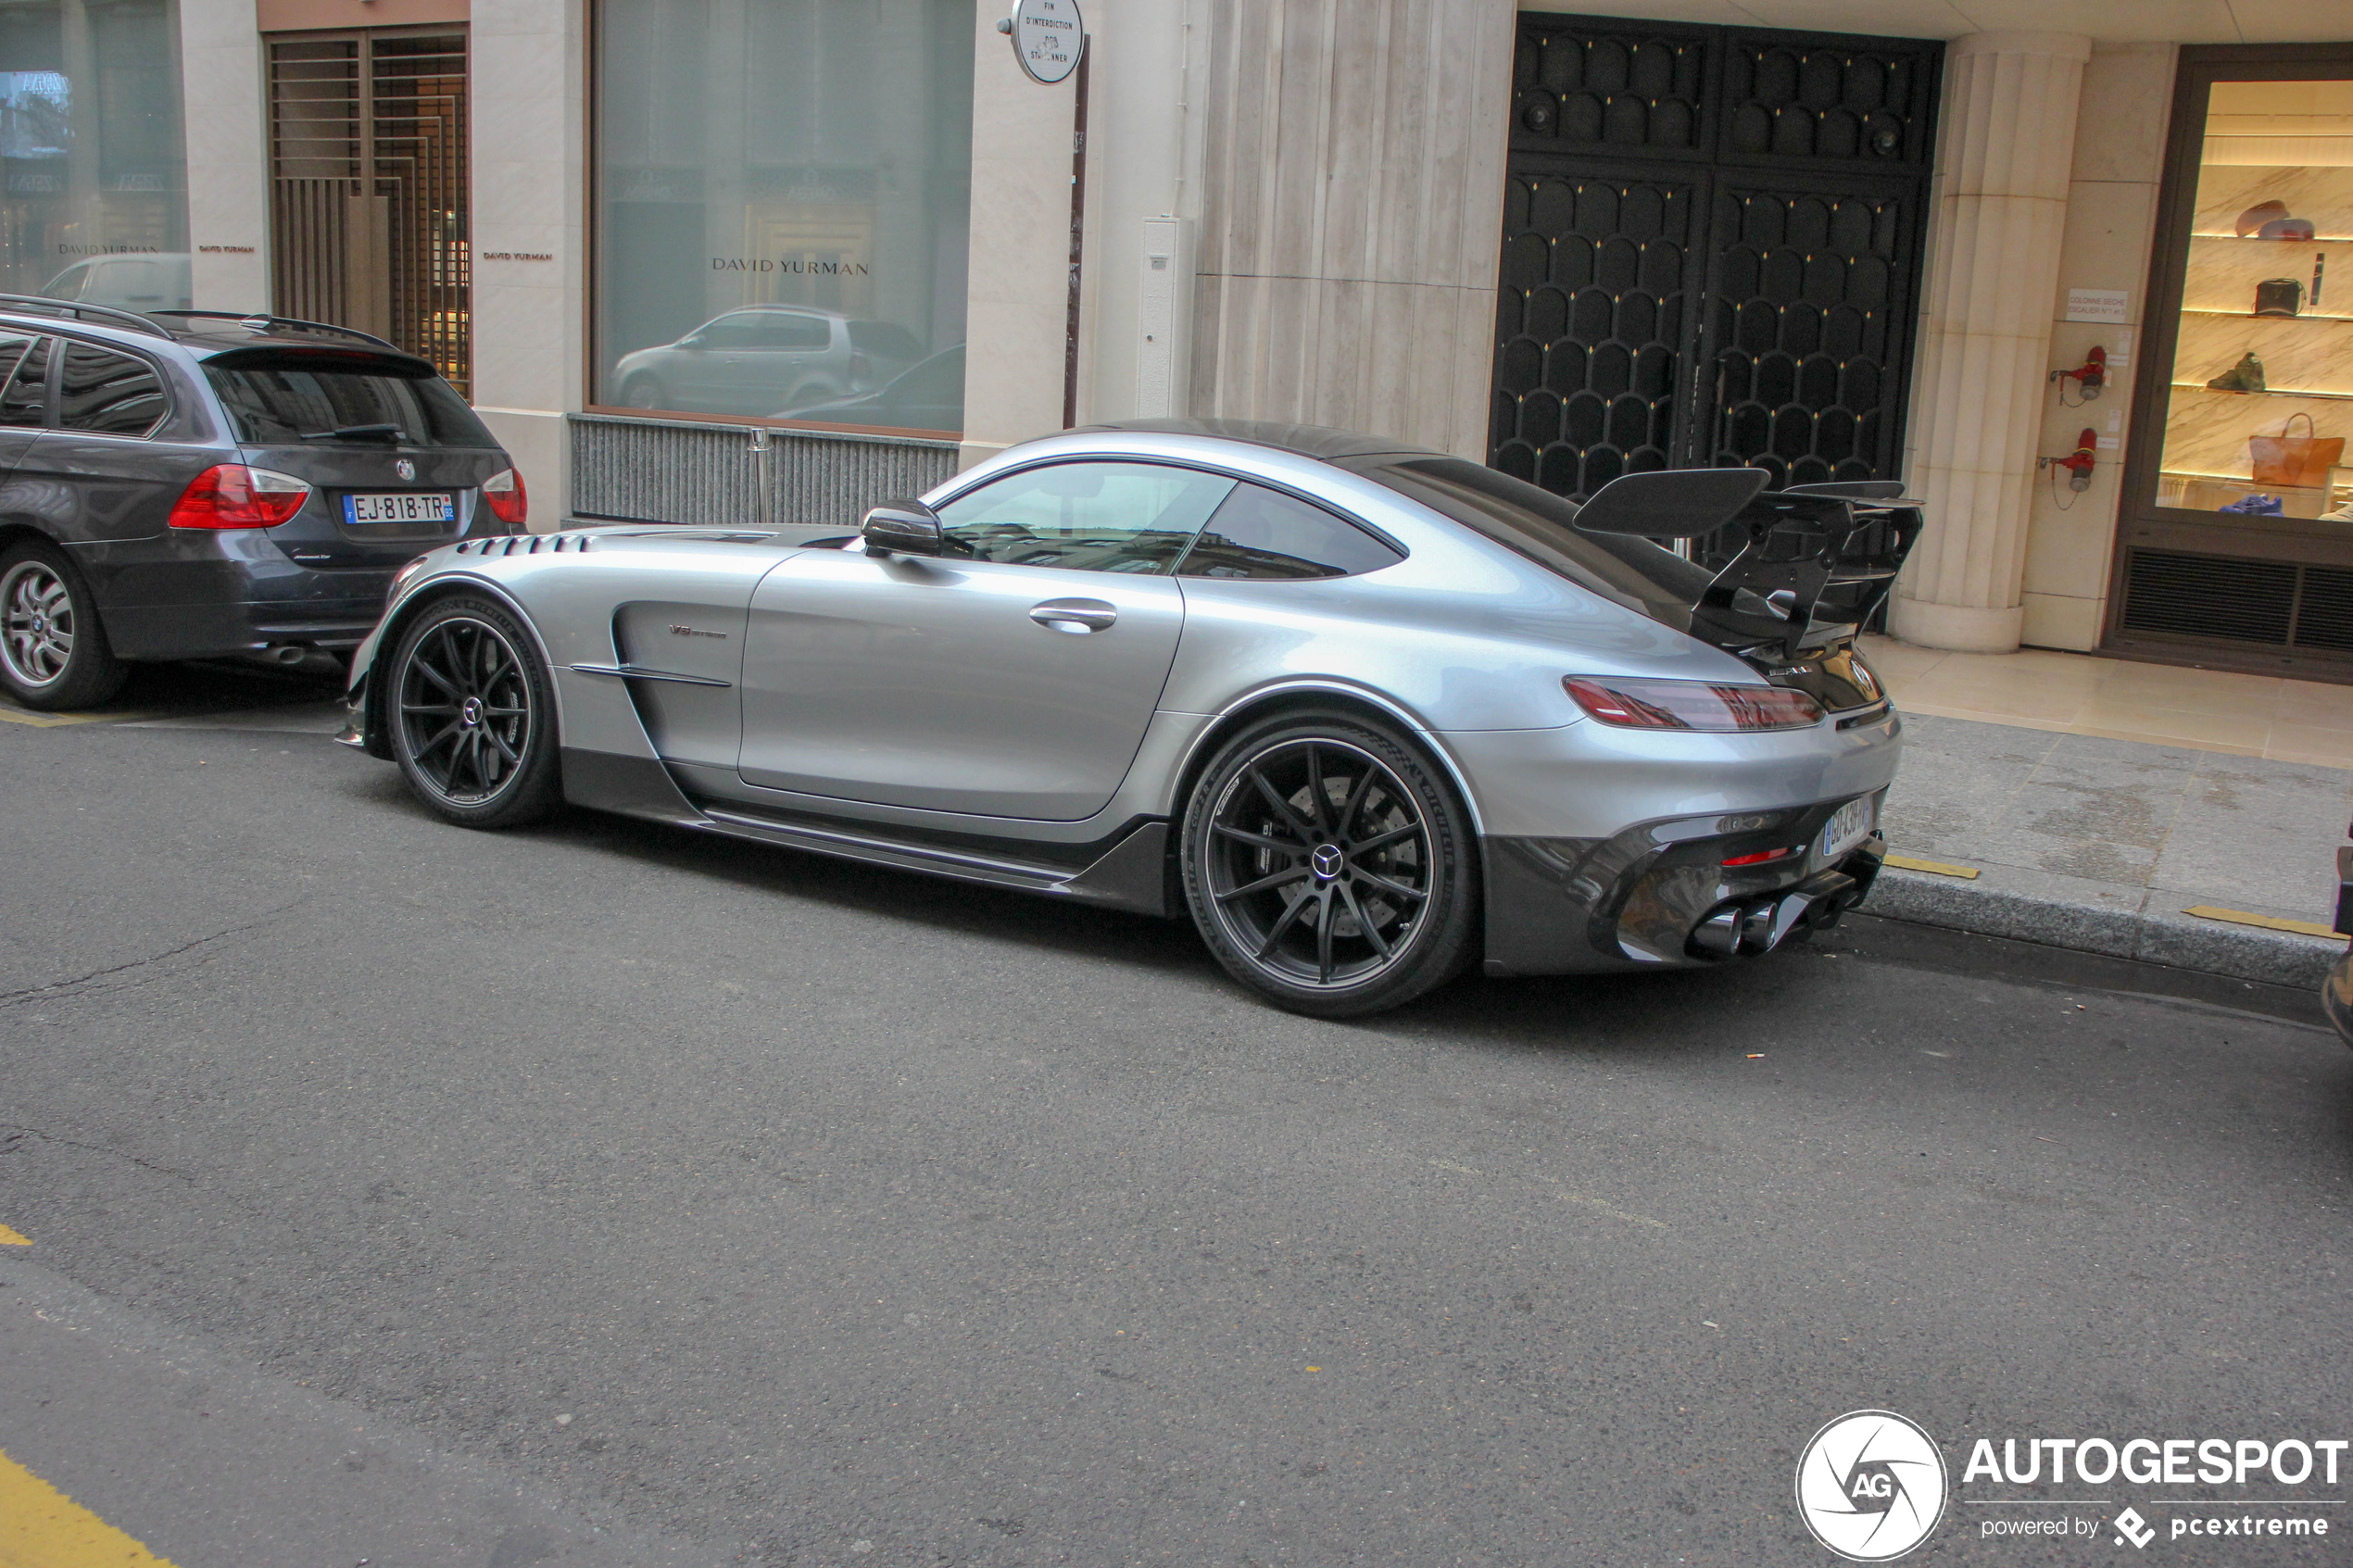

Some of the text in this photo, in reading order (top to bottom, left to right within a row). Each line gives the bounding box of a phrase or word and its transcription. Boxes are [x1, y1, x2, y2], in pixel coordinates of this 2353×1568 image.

[1044, 2, 1054, 10] FIN
[1026, 17, 1073, 30] D'INTERDICTION
[58, 244, 159, 256] DAVID YURMAN
[199, 245, 255, 255] DAVID YURMAN
[484, 252, 553, 261] DAVID YURMAN
[712, 257, 869, 276] DAVID YURMAN
[2070, 296, 2126, 307] COLONNE SECHE
[2067, 306, 2100, 314] ESCALIER
[445, 508, 454, 518] 92
[1421, 781, 1454, 860] MICHELIN
